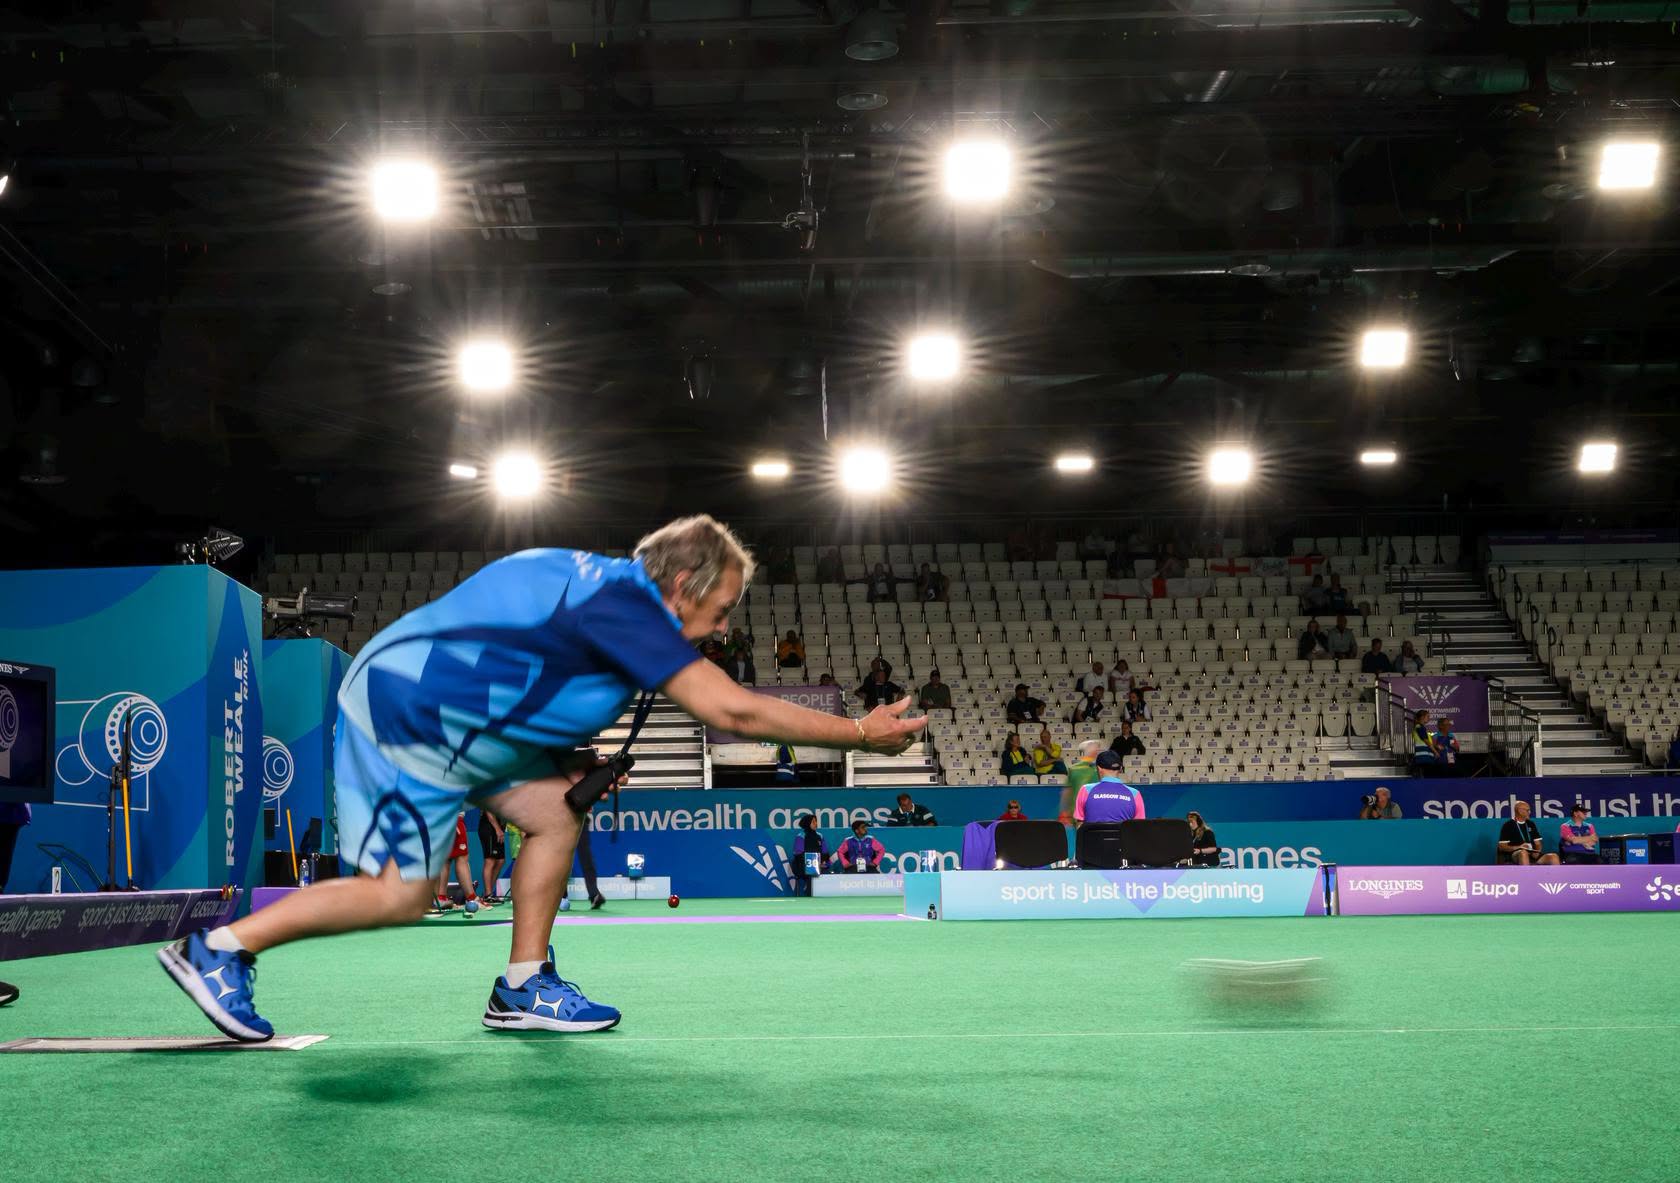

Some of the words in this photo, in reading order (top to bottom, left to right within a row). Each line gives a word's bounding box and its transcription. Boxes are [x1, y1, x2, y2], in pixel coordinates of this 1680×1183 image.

[234, 656, 244, 793] WEALE
[225, 700, 235, 866] ROBERT
[1534, 794, 1564, 818] is
[1219, 846, 1322, 869] ames
[54, 870, 61, 894] 2
[1000, 882, 1055, 903] sport
[1062, 882, 1079, 900] is
[1083, 881, 1120, 903] just
[1125, 881, 1159, 900] the
[1163, 880, 1264, 903] beginning
[1349, 880, 1424, 891] LONGINES
[1472, 881, 1519, 898] Bupa
[0, 904, 29, 933] ealth
[21, 909, 66, 939] games
